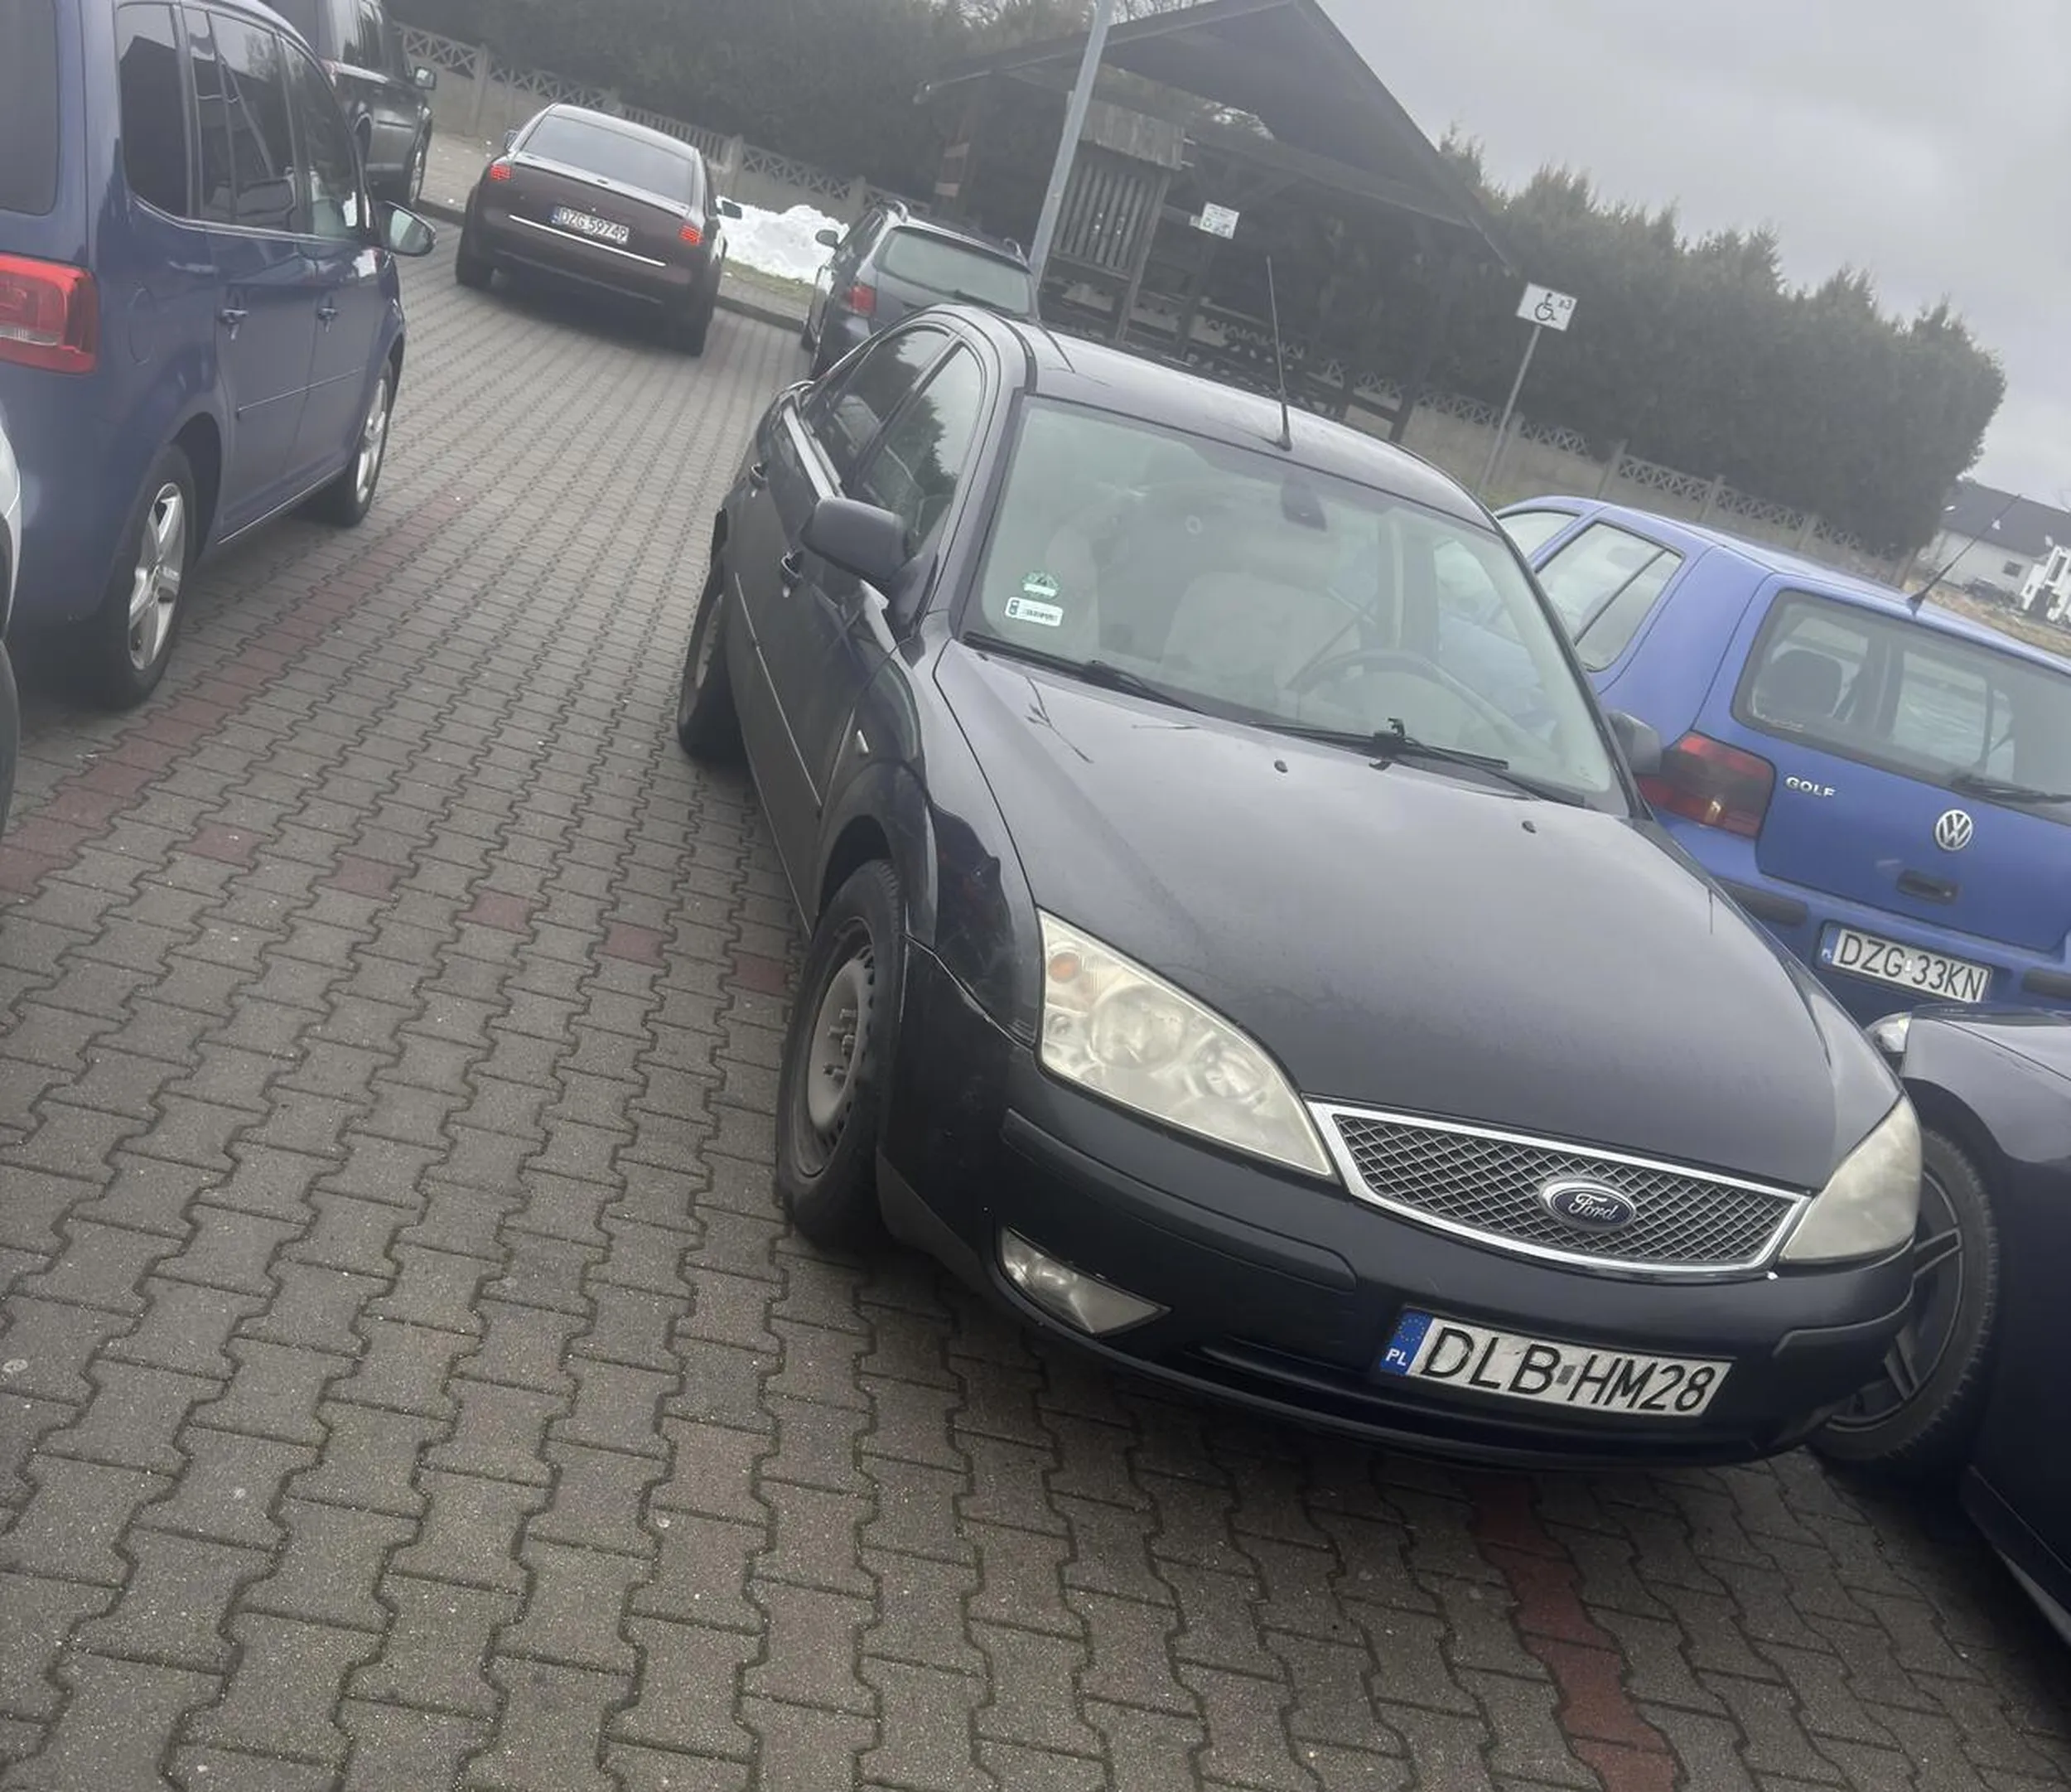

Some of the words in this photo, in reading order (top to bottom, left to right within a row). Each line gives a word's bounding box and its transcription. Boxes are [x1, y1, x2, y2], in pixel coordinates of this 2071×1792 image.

[1786, 776, 1837, 798] GOLF
[1838, 933, 1906, 978] DZG
[1911, 954, 1985, 1002] 33KN
[1568, 1192, 1619, 1222] Ford
[1385, 1347, 1407, 1366] PL
[1420, 1326, 1562, 1395] DLB
[1567, 1353, 1716, 1412] HM28
